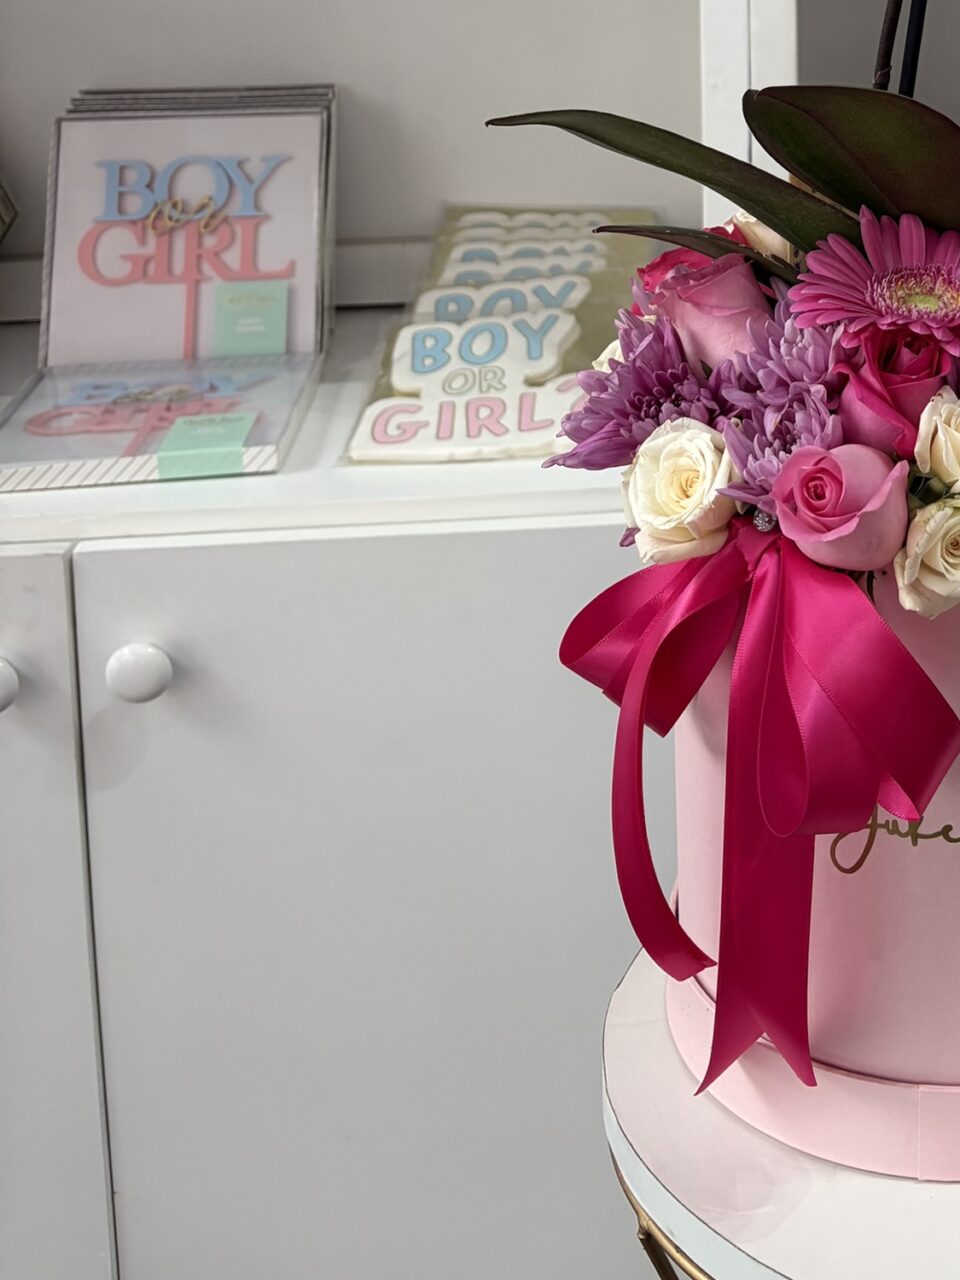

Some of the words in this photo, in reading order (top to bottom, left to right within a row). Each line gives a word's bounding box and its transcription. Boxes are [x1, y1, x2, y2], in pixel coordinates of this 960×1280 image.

[94, 154, 293, 223] BOY
[76, 214, 296, 287] GIRL
[411, 312, 561, 375] BOY
[441, 364, 507, 396] OR
[370, 391, 555, 445] GIRL
